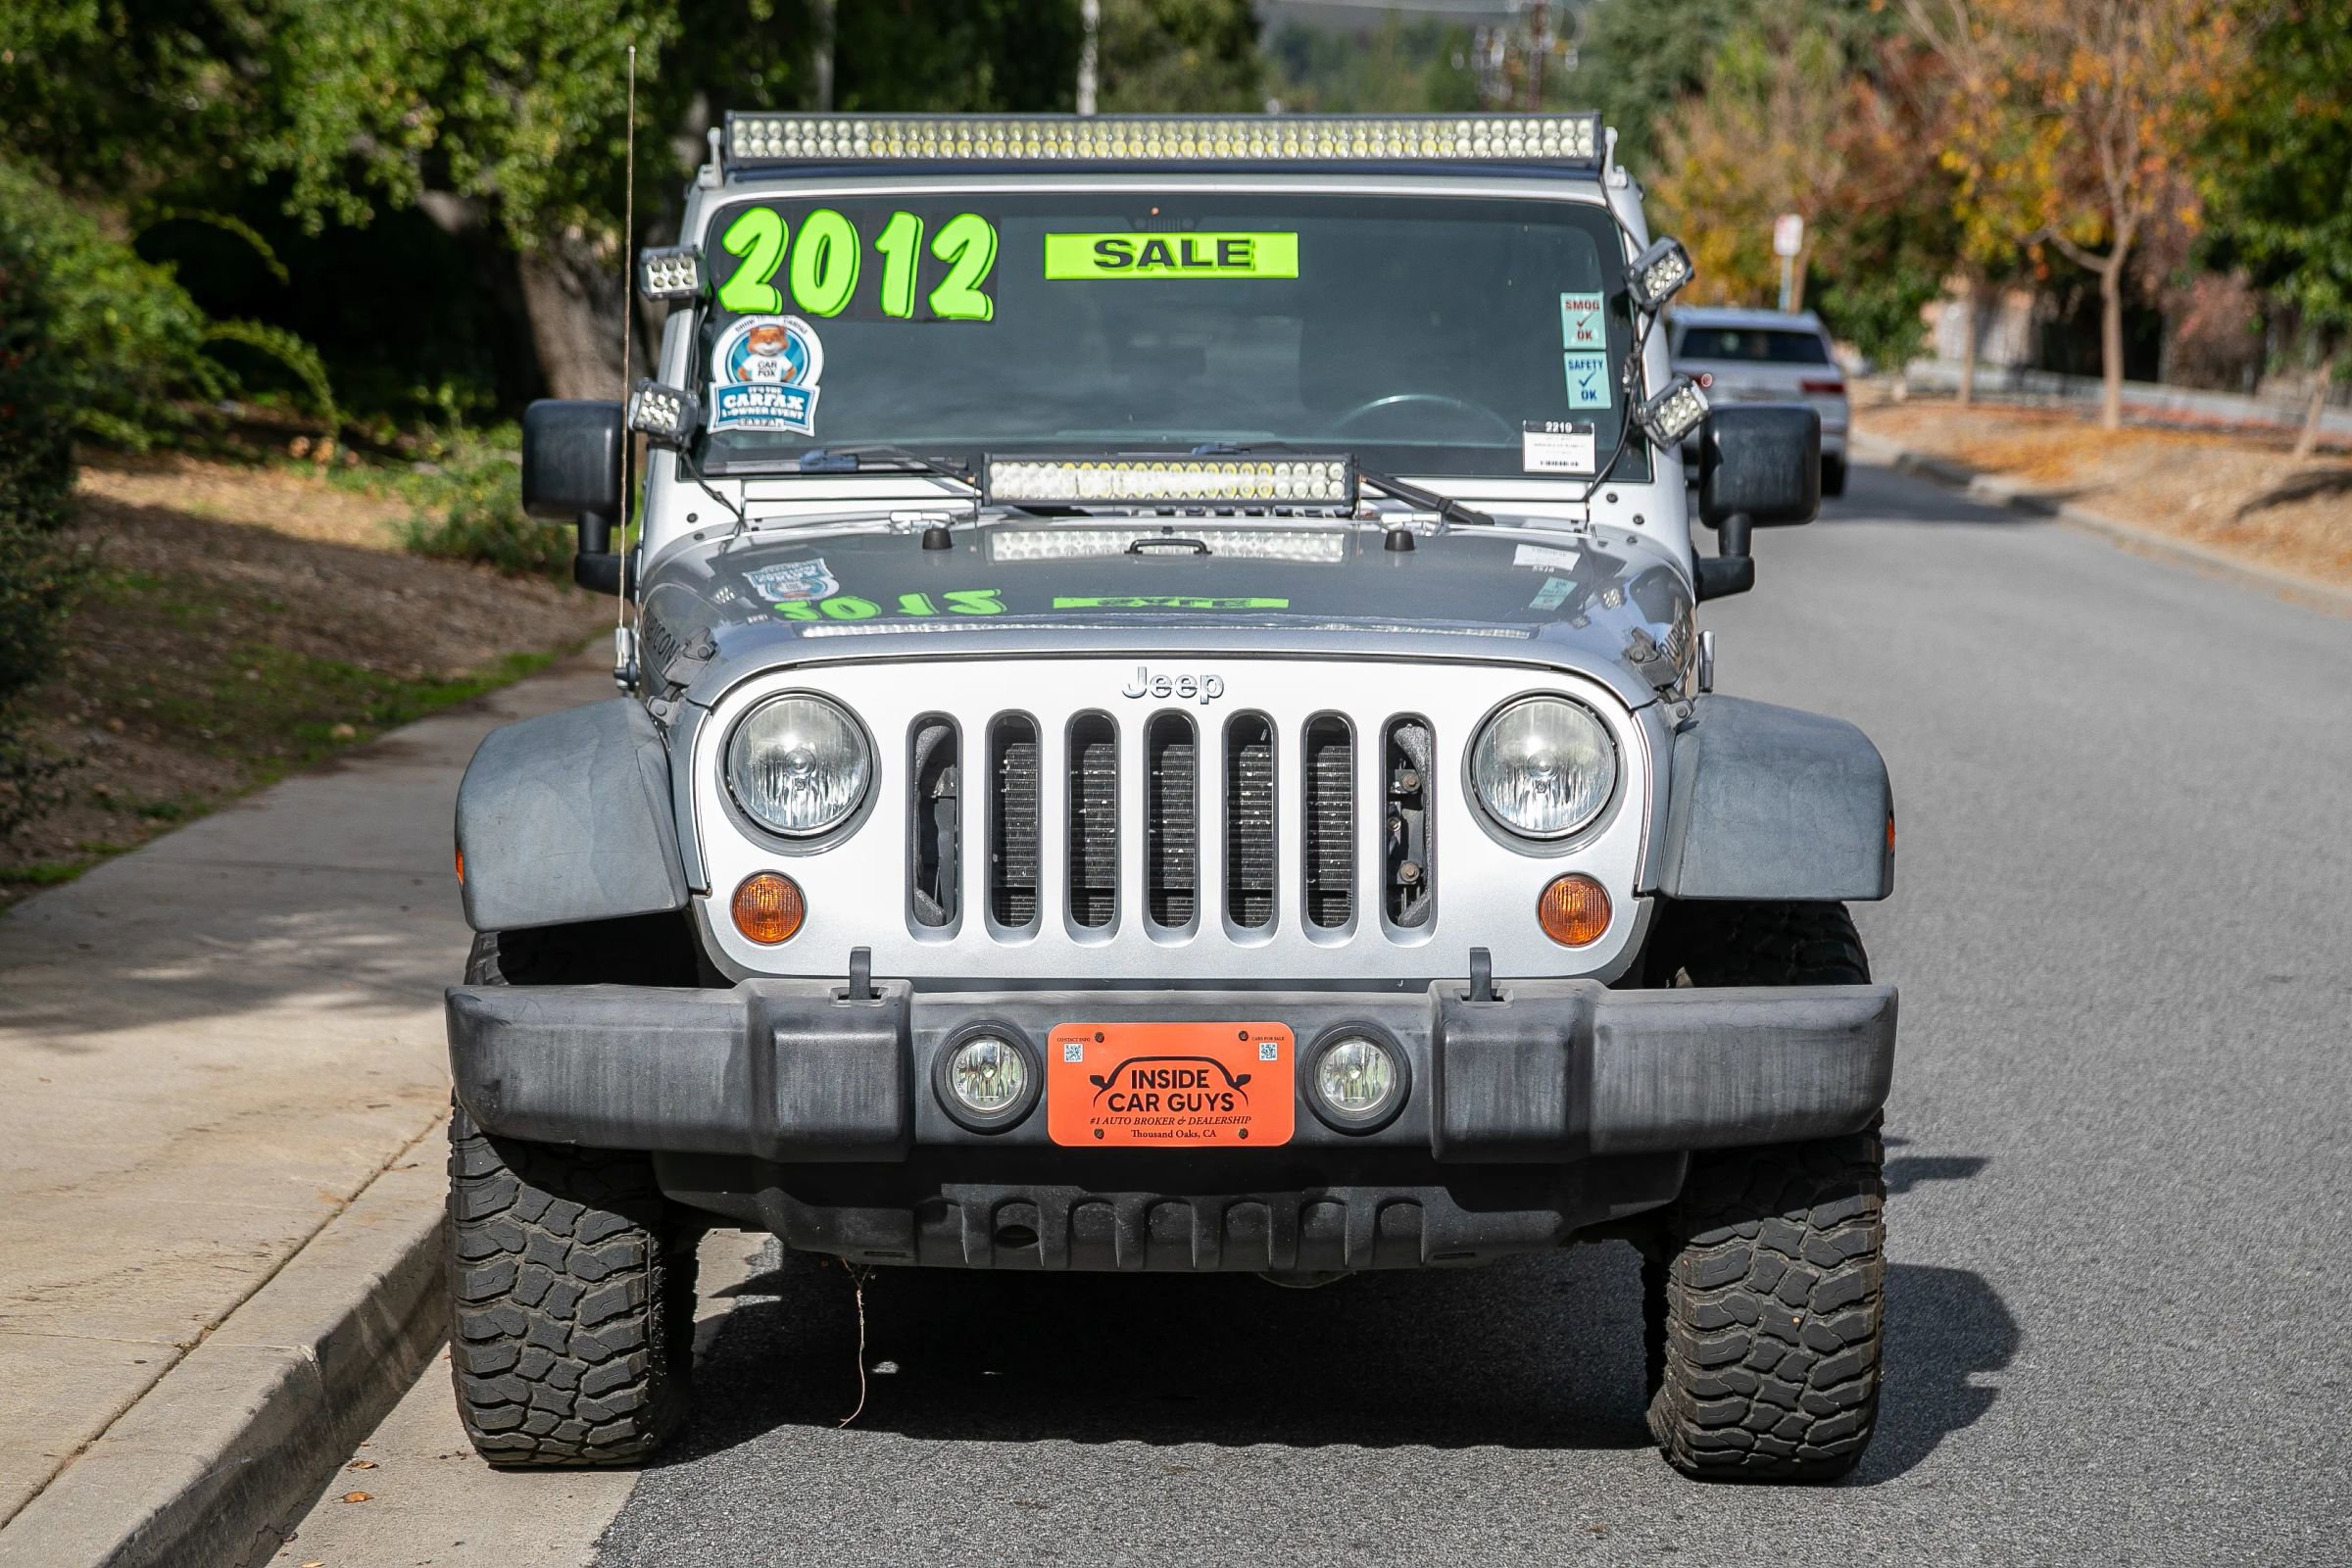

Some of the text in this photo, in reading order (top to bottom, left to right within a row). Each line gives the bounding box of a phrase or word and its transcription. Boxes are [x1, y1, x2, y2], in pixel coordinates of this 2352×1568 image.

[1094, 238, 1255, 271] SALE
[717, 207, 998, 321] 2012
[1565, 299, 1599, 311] SMOG
[1577, 330, 1592, 341] OK
[1568, 359, 1603, 370] SAFETY
[723, 393, 805, 410] CARFAX
[1581, 390, 1596, 401] OK
[1122, 666, 1224, 705] Jeep
[1131, 1069, 1210, 1089] INSIDE
[1107, 1093, 1234, 1112] CAR GUYS
[1102, 1116, 1132, 1125] AUTO
[1134, 1116, 1175, 1125] BROKER
[1177, 1116, 1186, 1125] &
[1188, 1115, 1251, 1125] DEALERSHIP
[1131, 1129, 1216, 1139] Thousand Oaks, CA
